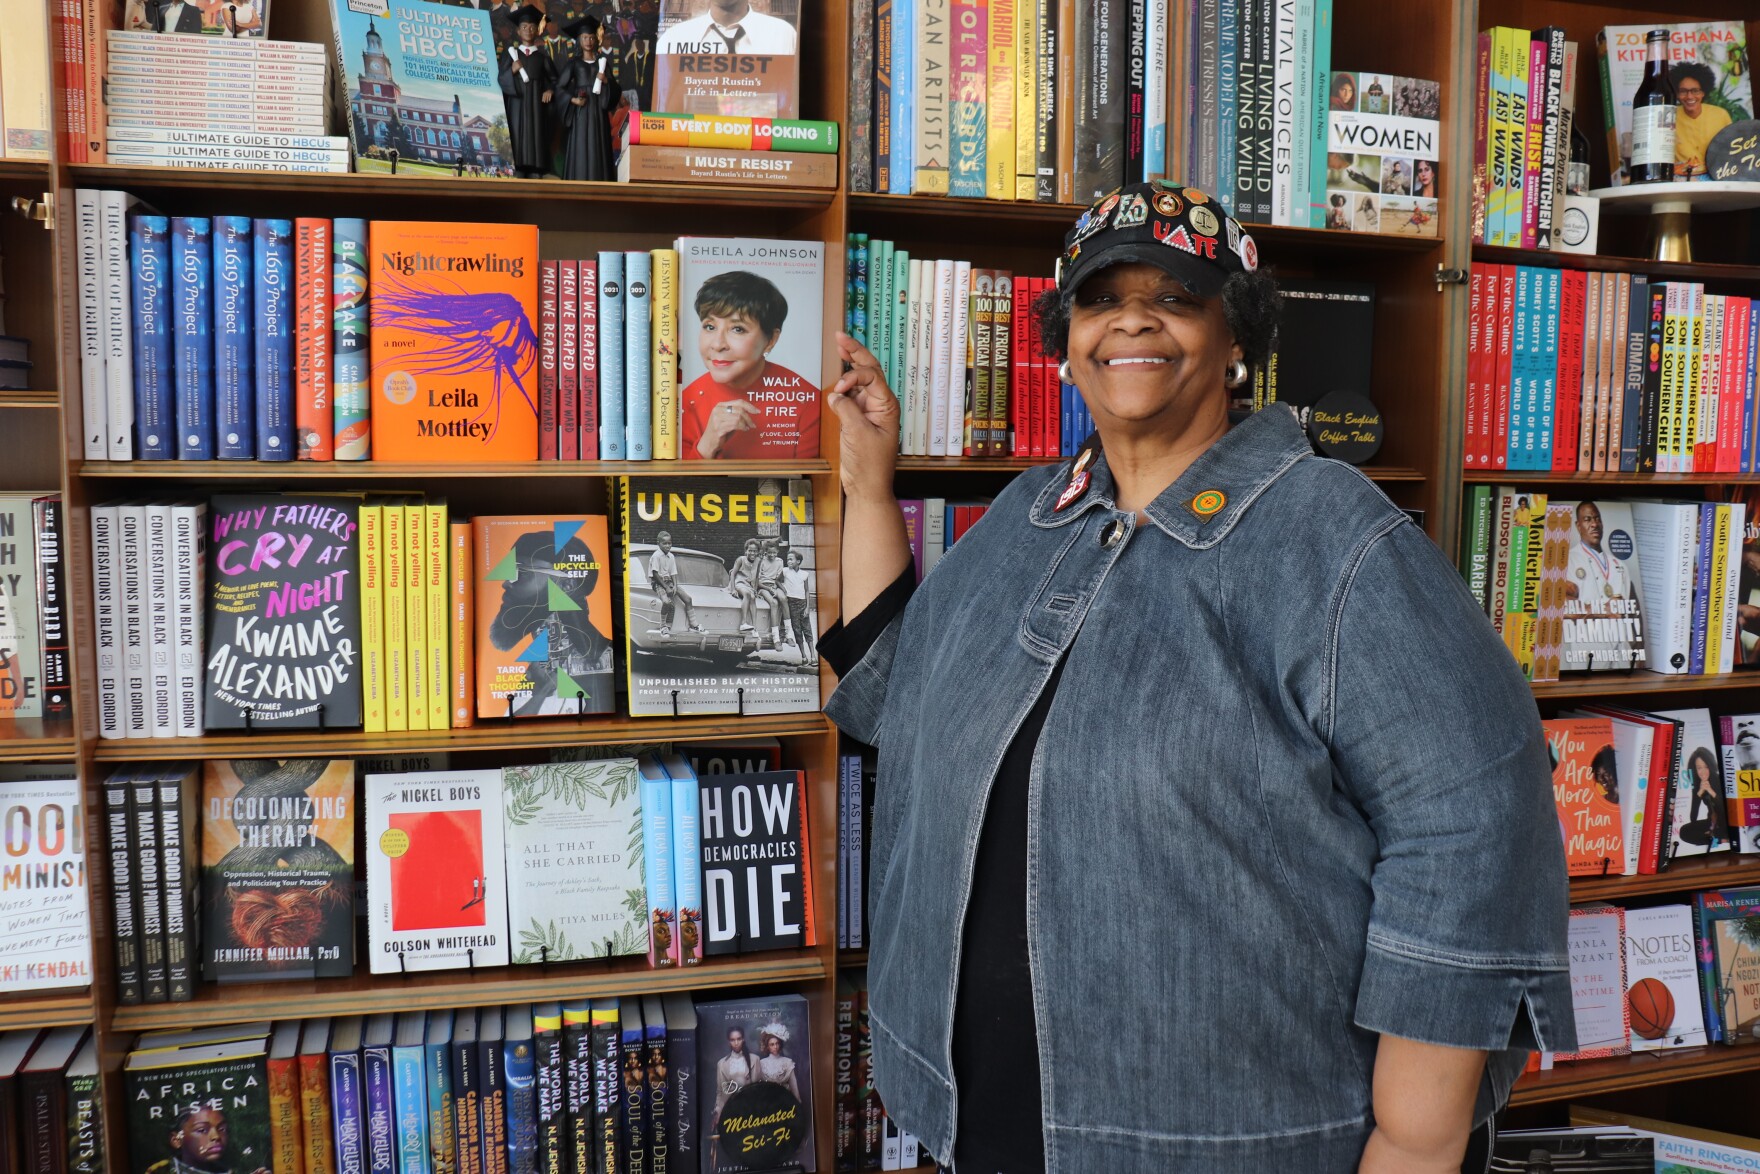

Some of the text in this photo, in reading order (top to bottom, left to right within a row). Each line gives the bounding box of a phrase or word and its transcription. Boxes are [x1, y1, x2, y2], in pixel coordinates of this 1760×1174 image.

[401, 8, 481, 31] ULTIMATE
[399, 22, 482, 45] GUIDE TO
[1672, 31, 1736, 44] GHANA
[668, 42, 722, 54] I MUST
[404, 61, 489, 79] 101 HISTORICALLY BLACK
[679, 56, 772, 73] RESIST
[405, 70, 435, 80] COLLEGES
[450, 75, 491, 86] UNIVERSITIES
[684, 77, 761, 86] Bayard Rustin's
[1277, 2, 1293, 174] VITAL VOICES
[687, 88, 706, 97] Life
[723, 89, 757, 97] Letters
[925, 59, 942, 150] ARTISTS
[672, 120, 817, 140] EVERY BODY LOOKING
[1238, 63, 1254, 192] LIVING WILD
[1334, 124, 1431, 151] WOMEN
[1494, 90, 1508, 188] EAST WINDS
[172, 131, 330, 148] ULTIMATE GUIDE TO HBCUs
[1538, 69, 1561, 229] BLACK POWER KITCHEN
[1528, 132, 1542, 171] RISE
[1556, 108, 1571, 195] MIXTAPE POTLUCK
[692, 246, 817, 258] SHEILA JOHNSON
[382, 252, 524, 277] Nightcrawling
[138, 227, 158, 335] The 1619 Project
[342, 241, 356, 347] BLACK CAKE
[976, 299, 992, 312] 100
[313, 226, 326, 410] WHEN CRACK WAS KING
[543, 267, 554, 370] MEN WE REAPED
[976, 313, 992, 322] BEST
[392, 339, 416, 348] novel
[976, 324, 990, 418] AFRICAN AMERICAN
[1628, 332, 1644, 390] HOMAGE
[763, 377, 800, 387] WALK
[428, 390, 478, 408] Leila
[747, 392, 815, 401] THROUGH
[1658, 353, 1673, 452] SOUTHERN CHEF
[766, 407, 797, 416] FIRE
[1315, 412, 1379, 427] Black English
[417, 419, 492, 442] Mottley
[1319, 430, 1375, 443] Coffee Table
[637, 493, 806, 523] UNSEEN
[214, 504, 356, 542] WHY FATHERS
[217, 532, 347, 576] CRY AT
[554, 562, 601, 571] UPCYCLED
[96, 517, 112, 647] CONVERSATIONS IN BLACK
[266, 570, 349, 618] NIGHT
[1610, 600, 1639, 613] CHEF,
[236, 605, 344, 658] KWAME
[1565, 619, 1641, 642] DAMMIT!
[208, 639, 356, 700] ALEXANDER
[496, 674, 528, 682] BLACK
[497, 666, 526, 674] TARIQ
[489, 682, 534, 691] THOUGHT
[639, 678, 718, 686] UNPUBLISHED
[722, 678, 759, 686] BLACK
[1553, 731, 1584, 762] You
[1565, 759, 1593, 785] Are
[402, 787, 480, 802] NICKEL BOYS
[1553, 785, 1594, 807] More
[210, 797, 346, 820] DECOLONIZING
[701, 783, 793, 838] HOW
[110, 814, 126, 849] MAKE
[1574, 811, 1611, 831] Than
[238, 825, 319, 847] THERAPY
[524, 842, 594, 853] ALL THAT
[1569, 835, 1621, 857] Magic
[524, 854, 621, 868] SHE CARRIED
[705, 842, 795, 862] DEMOCRACIES
[114, 852, 128, 884] GOOD
[224, 870, 266, 878] Oppression,
[268, 870, 301, 878] Historical
[243, 880, 280, 888] Politicizing
[115, 891, 133, 937] PROMISES
[706, 864, 800, 941] DIE
[214, 948, 263, 962] JENNIFER
[268, 948, 313, 962] MULLAN,
[384, 935, 496, 952] COLSON WHITEHEAD
[1628, 934, 1691, 956] NOTES
[1665, 955, 1688, 964] COACH
[839, 1002, 851, 1094] RELATIONS
[608, 1034, 618, 1106] THE WORLD
[136, 1075, 258, 1100] AFRICA
[597, 1059, 607, 1113] WE MAKE
[150, 1095, 247, 1119] RISEN
[723, 1105, 796, 1133] Melanated
[742, 1130, 791, 1153] Sci-Fi
